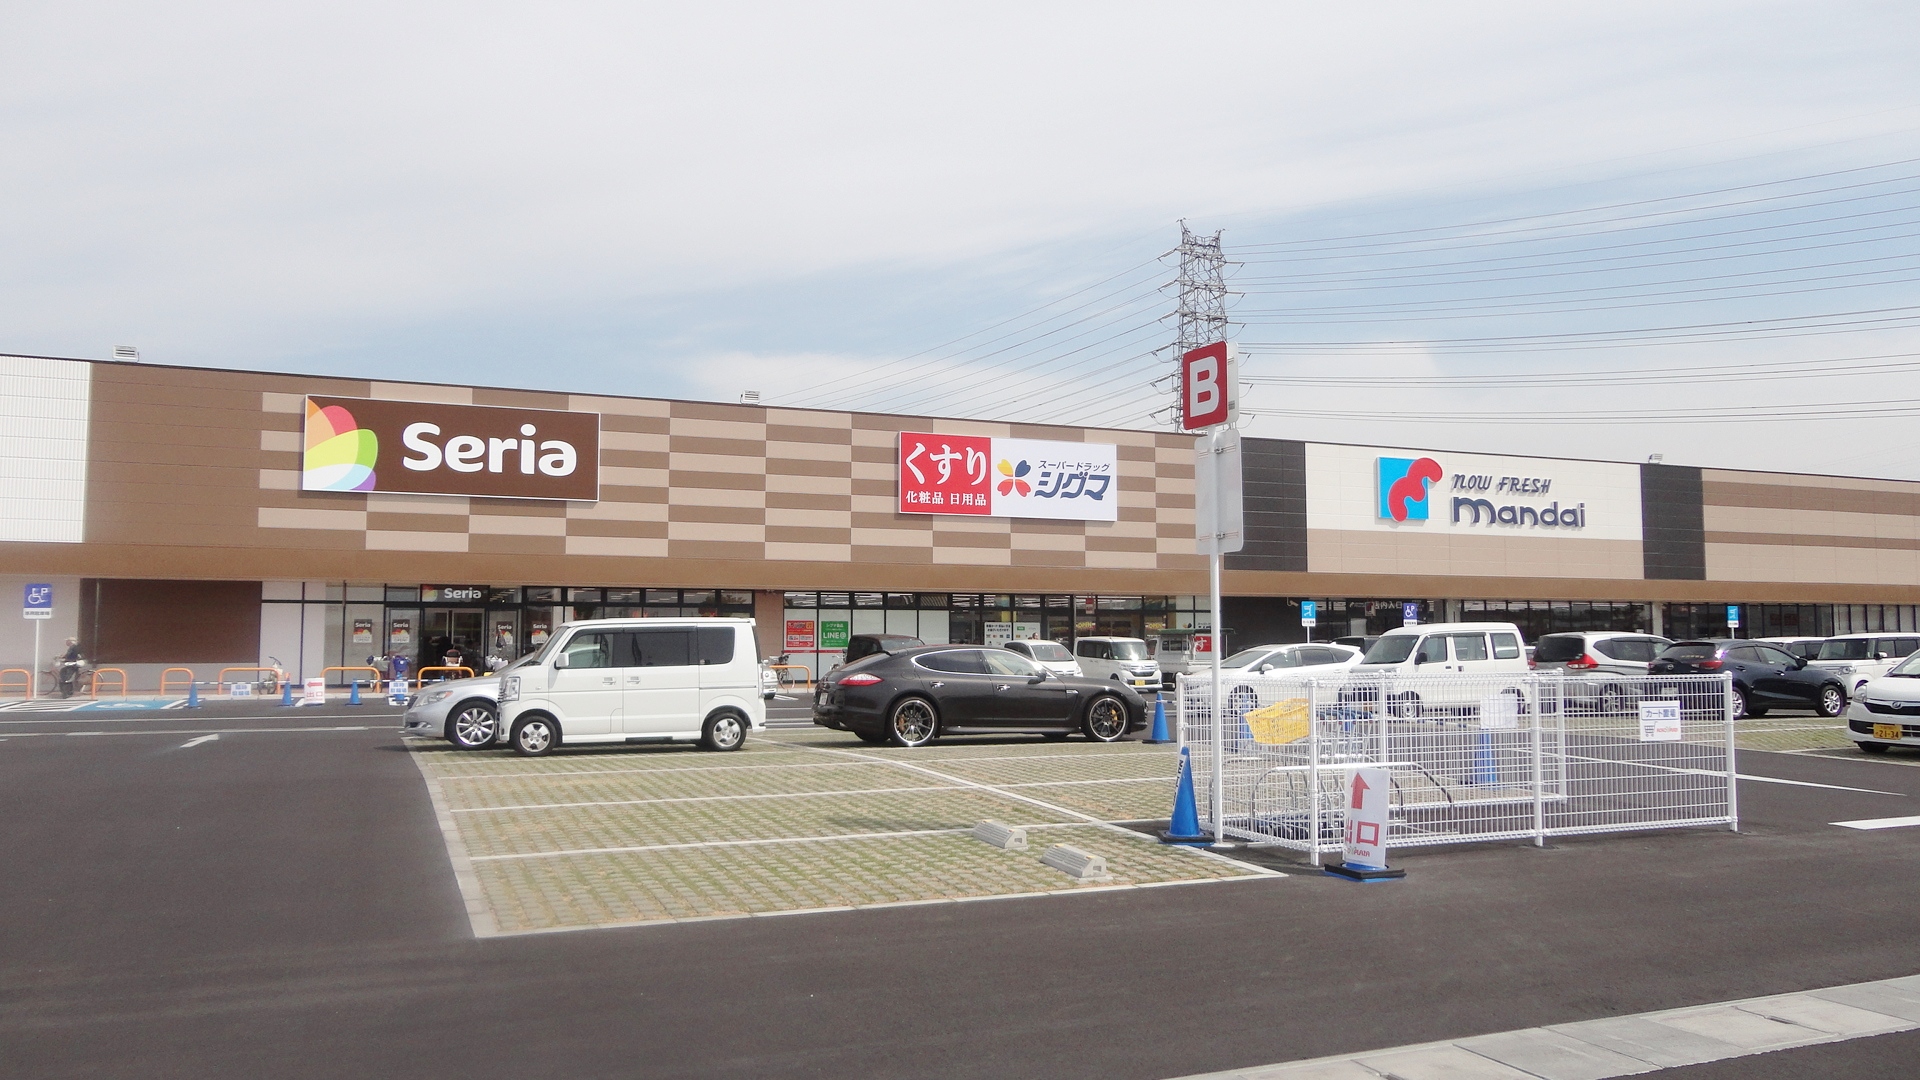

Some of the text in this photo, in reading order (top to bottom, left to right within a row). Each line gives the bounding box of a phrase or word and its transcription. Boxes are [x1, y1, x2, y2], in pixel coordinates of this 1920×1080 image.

[1189, 355, 1219, 418] B
[402, 422, 577, 476] Seria
[905, 442, 987, 486] くすり
[1038, 460, 1111, 472] スーパードラッグ
[1033, 471, 1111, 501] シグマ
[1499, 476, 1552, 494] FRESH
[906, 490, 987, 507] 化粧品 日用品
[1451, 496, 1586, 528] mandai
[40, 587, 49, 596] P
[444, 587, 482, 599] Seria
